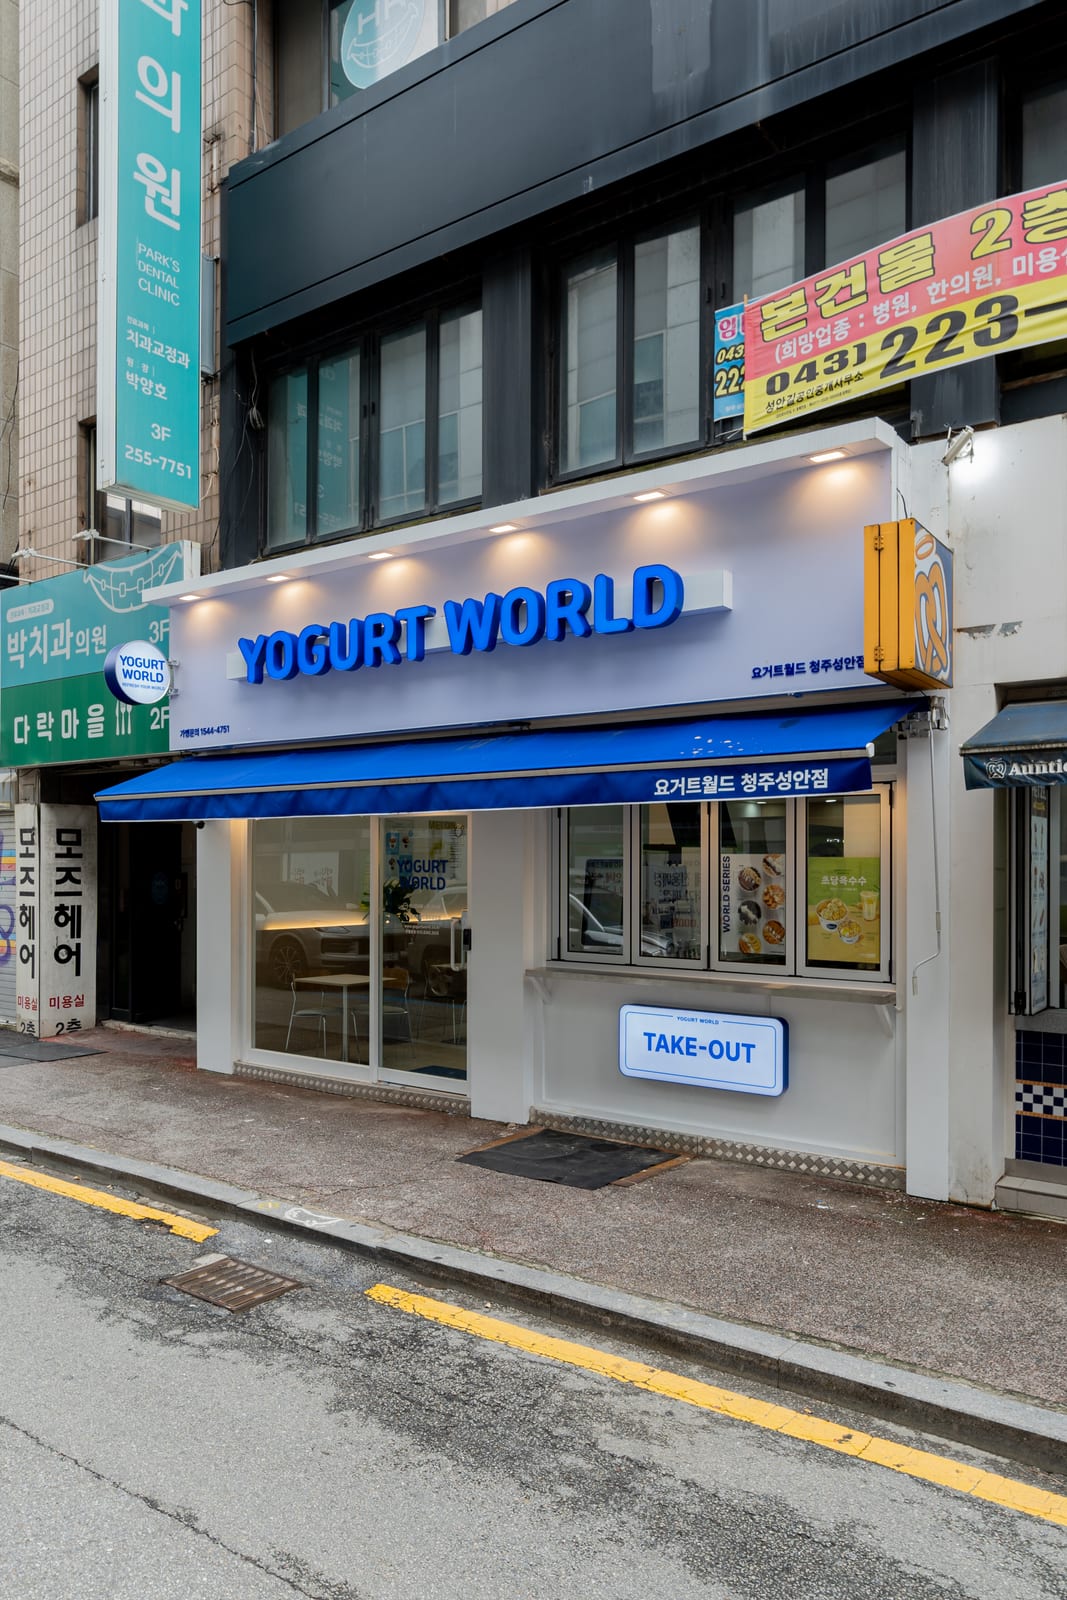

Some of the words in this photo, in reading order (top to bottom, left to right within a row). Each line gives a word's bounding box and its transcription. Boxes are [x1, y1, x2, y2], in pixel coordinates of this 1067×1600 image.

[138, 243, 180, 273] PARK'S
[138, 260, 179, 289] DENTAL
[760, 231, 935, 343] 본건물
[138, 277, 180, 306] CLINIC
[719, 313, 744, 340] 임
[775, 316, 851, 364] (희망업종
[873, 292, 917, 325] 병원,
[926, 263, 1002, 305] 한의원,
[126, 329, 190, 369] 치과교정과
[126, 371, 168, 400] 박양호
[151, 423, 171, 441] 3F
[125, 444, 191, 479] 255-7751
[149, 618, 169, 643] 3F
[238, 605, 435, 684] YOGURT
[444, 564, 684, 656] WORLD
[120, 655, 165, 670] YOGURT
[122, 668, 164, 683] WORLD
[751, 662, 806, 679] 요거트월드
[14, 703, 105, 745] 다락마을
[150, 706, 169, 730] 2F
[654, 775, 736, 796] 요거트월드
[741, 768, 829, 792] 청주성안점
[397, 859, 449, 873] YOGURT
[722, 855, 731, 892] SERIES
[400, 876, 446, 890] WORLD
[19, 828, 36, 979] 모즈헤어
[54, 828, 83, 977] 모즈헤어
[723, 894, 731, 933] WORLD
[17, 995, 38, 1012] 미용실
[49, 994, 85, 1009] 미용실
[699, 1017, 720, 1025] WORLD
[643, 1031, 756, 1063] TAKE-OUT
